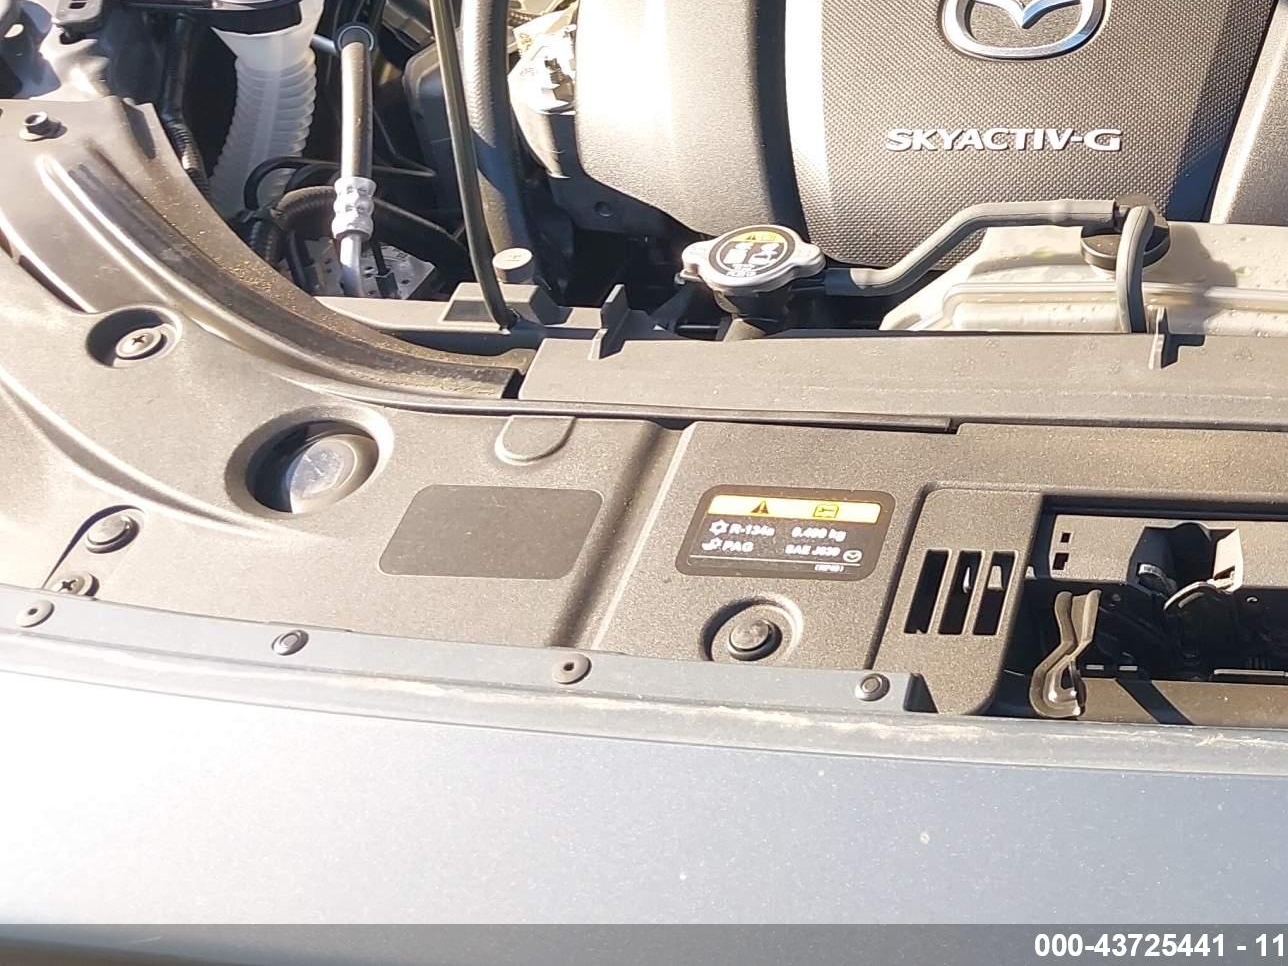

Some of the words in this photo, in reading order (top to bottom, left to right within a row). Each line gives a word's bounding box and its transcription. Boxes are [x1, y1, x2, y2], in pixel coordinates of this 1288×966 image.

[885, 127, 1122, 152] SKYACTIV-G
[728, 523, 776, 537] R-134a
[828, 528, 847, 542] kg
[722, 540, 755, 553] PAG
